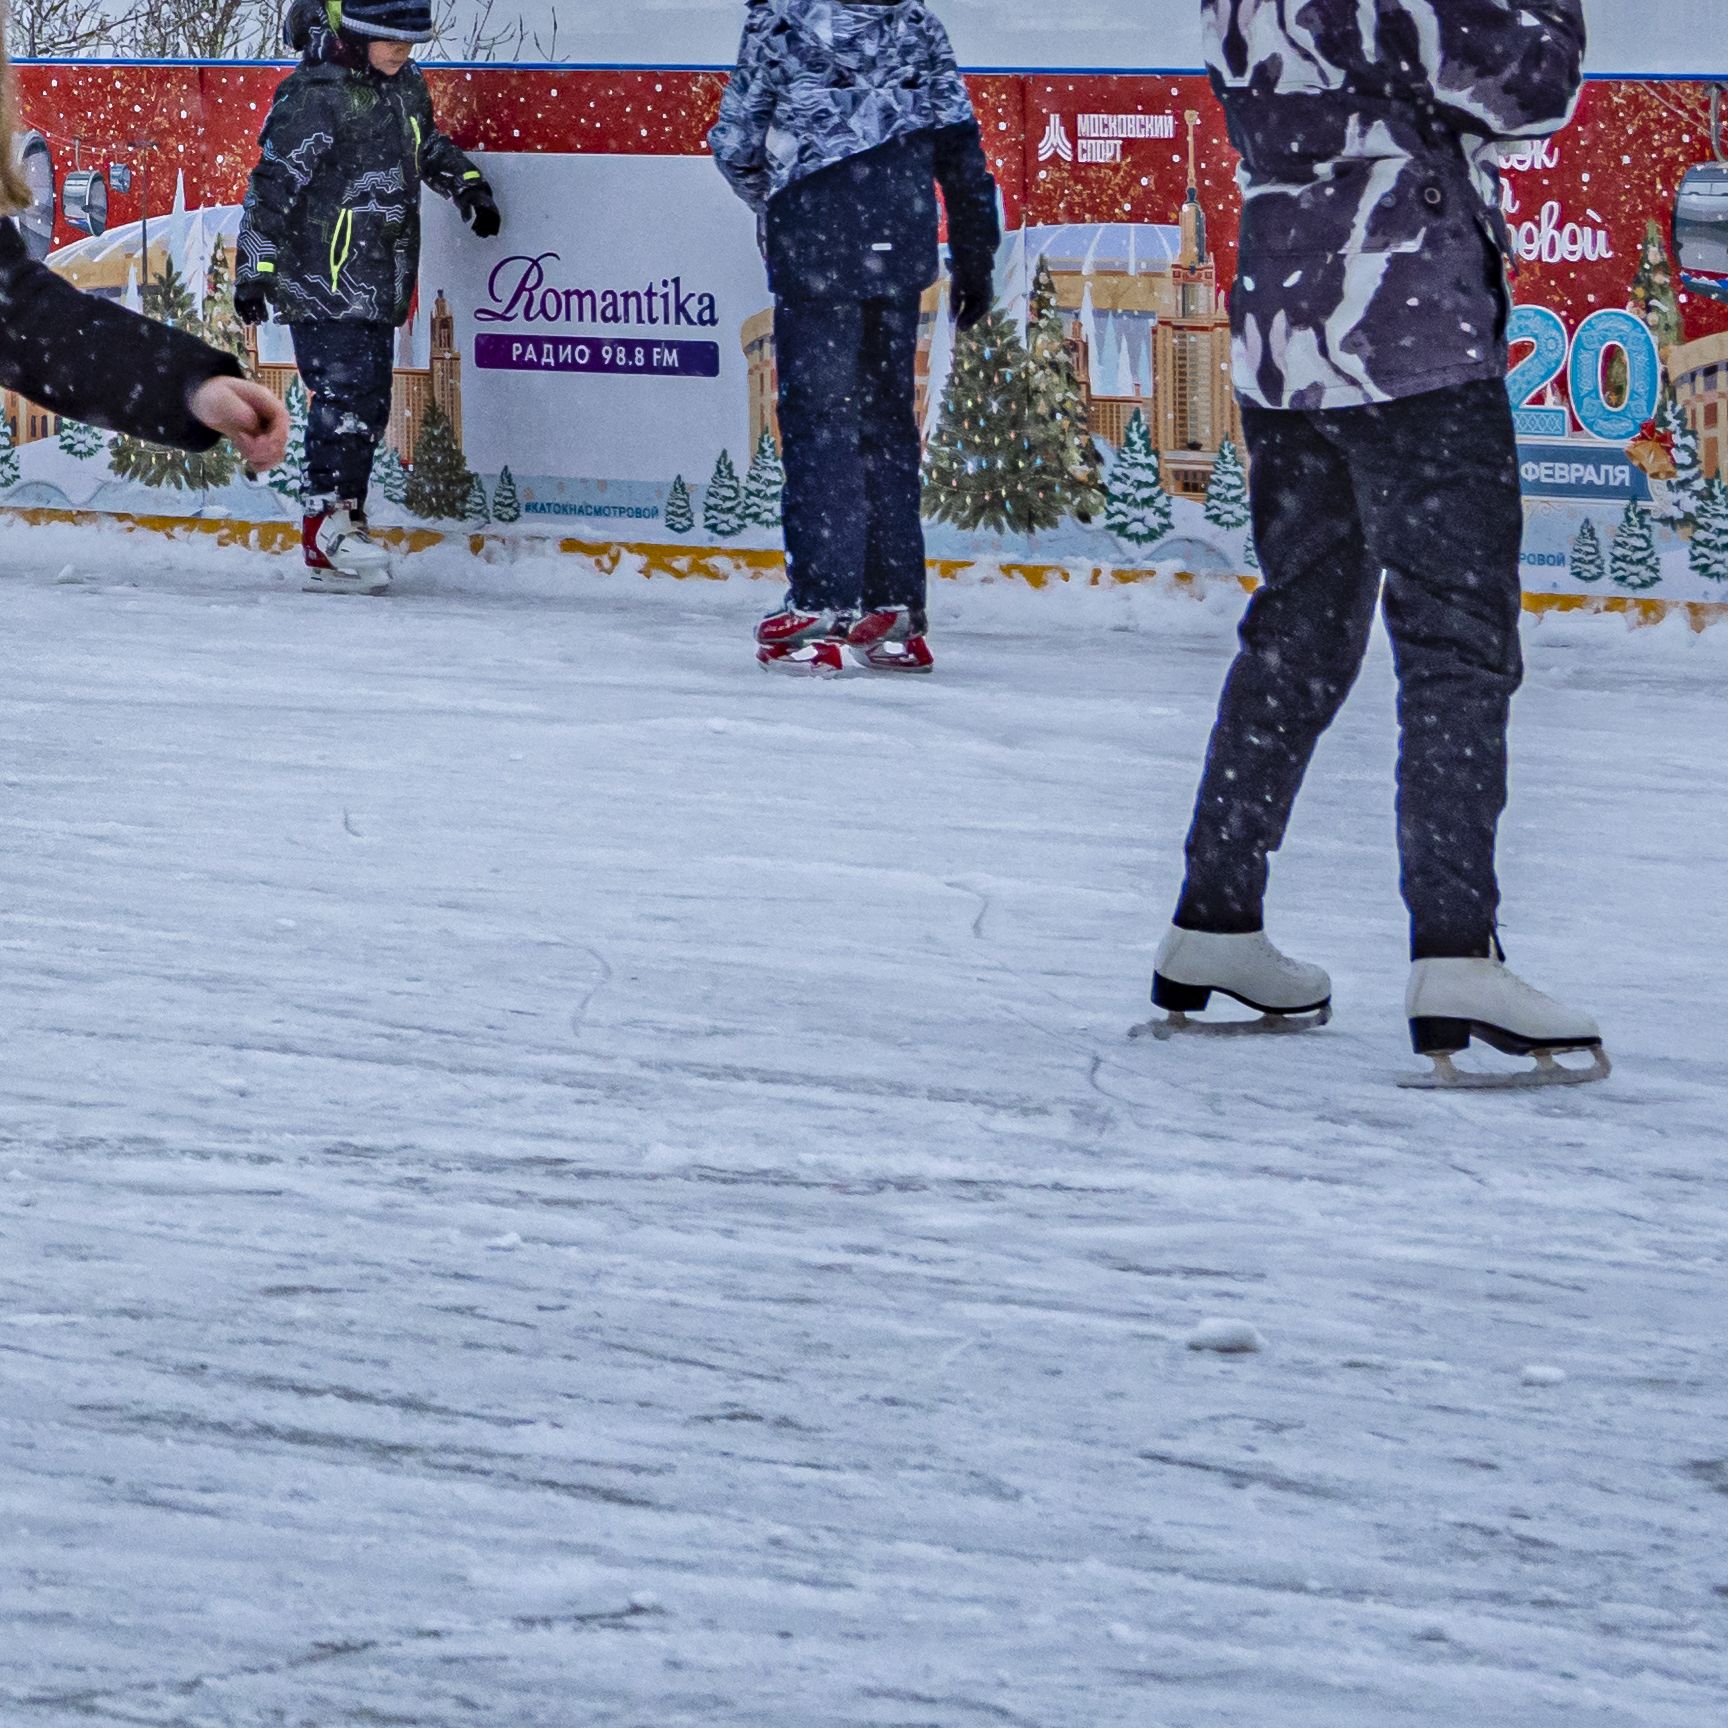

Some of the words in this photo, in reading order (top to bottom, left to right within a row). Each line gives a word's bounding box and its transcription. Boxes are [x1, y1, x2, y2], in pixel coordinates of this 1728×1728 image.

[1077, 110, 1174, 138] МОСКОВСКИЙ
[1077, 139, 1122, 163] СПОРТ
[474, 252, 720, 327] Romantika
[512, 343, 590, 366] РАДИО
[601, 346, 645, 367] 98.8
[652, 348, 679, 367] FM
[1520, 461, 1630, 487] ФЕВРАЛЯ
